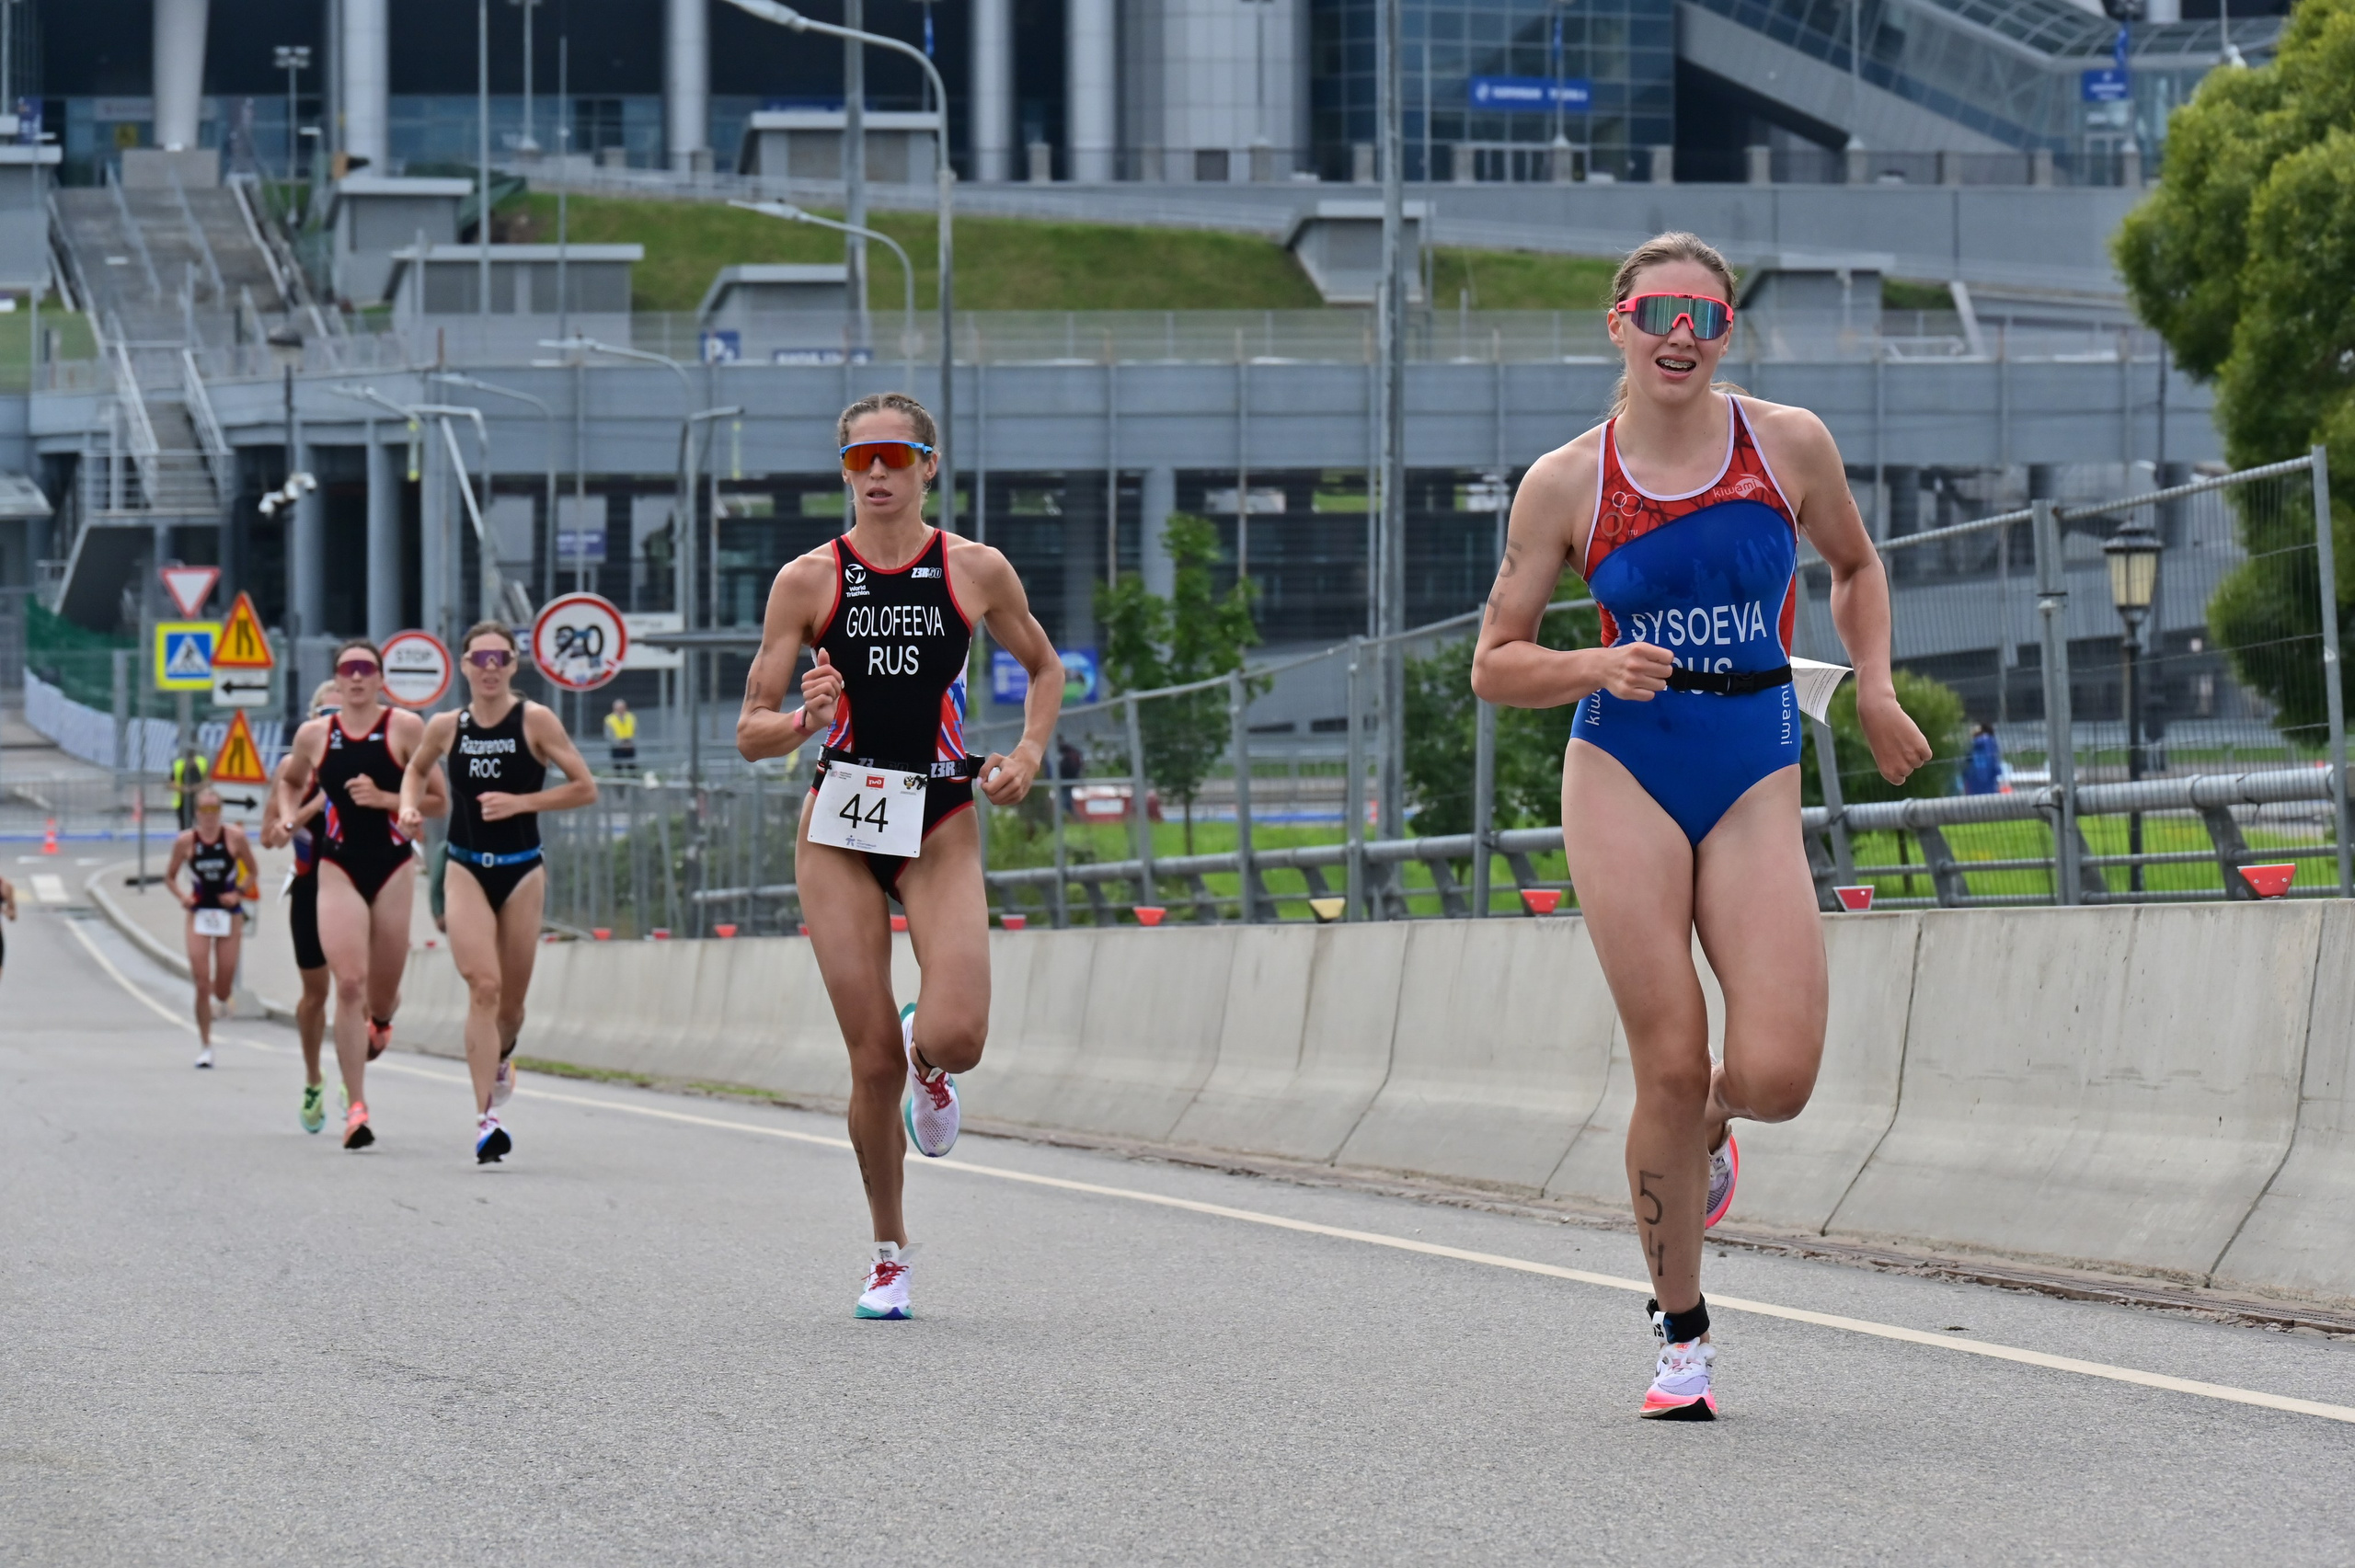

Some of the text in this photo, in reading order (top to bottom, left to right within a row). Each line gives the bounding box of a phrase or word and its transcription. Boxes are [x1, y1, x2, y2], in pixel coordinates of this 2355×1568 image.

[1712, 479, 1757, 498] kiwami
[846, 605, 946, 638] GOLOFEEVA
[1631, 601, 1768, 646] SYSOEVA
[867, 645, 920, 676] RUS
[1781, 683, 1793, 746] iwami
[468, 758, 502, 779] ROC
[839, 793, 889, 833] 44
[1639, 1170, 1665, 1277] 54
